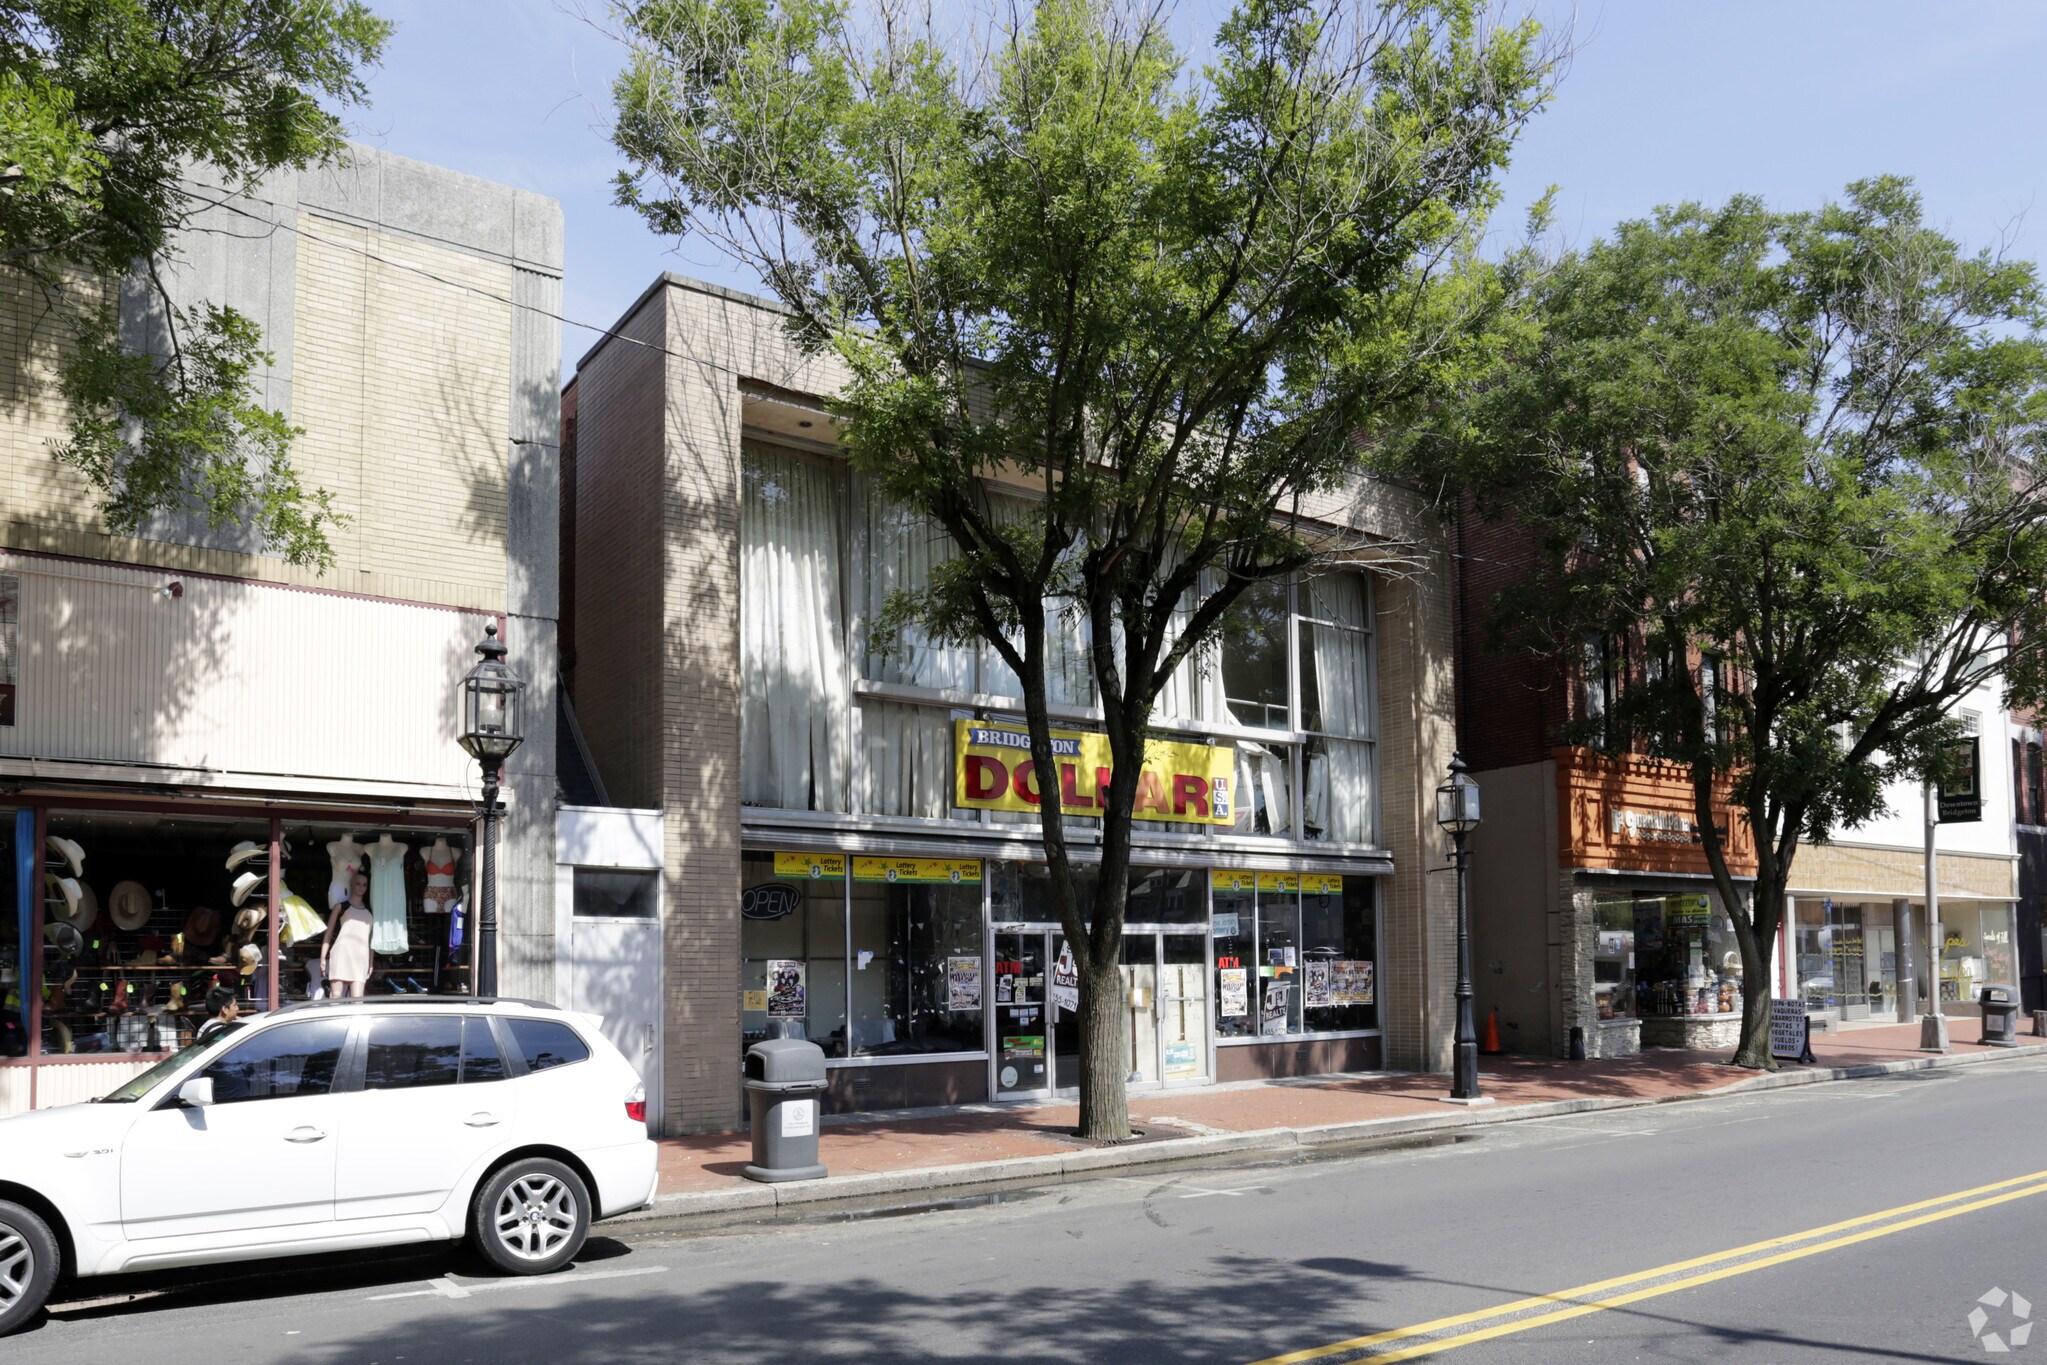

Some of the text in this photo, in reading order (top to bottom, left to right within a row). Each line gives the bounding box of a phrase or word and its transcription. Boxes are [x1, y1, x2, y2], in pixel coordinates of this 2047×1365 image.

[977, 730, 1074, 753] BRIDGON
[820, 857, 842, 866] Lottery
[896, 862, 916, 870] Lottery
[824, 864, 843, 872] Tickets
[959, 864, 978, 872] Lottery
[742, 890, 794, 912] OPEN
[1213, 926, 1229, 935] ottery
[996, 961, 1022, 974] ATM
[1056, 975, 1078, 986] REALT
[1265, 1006, 1286, 1020] REALTY
